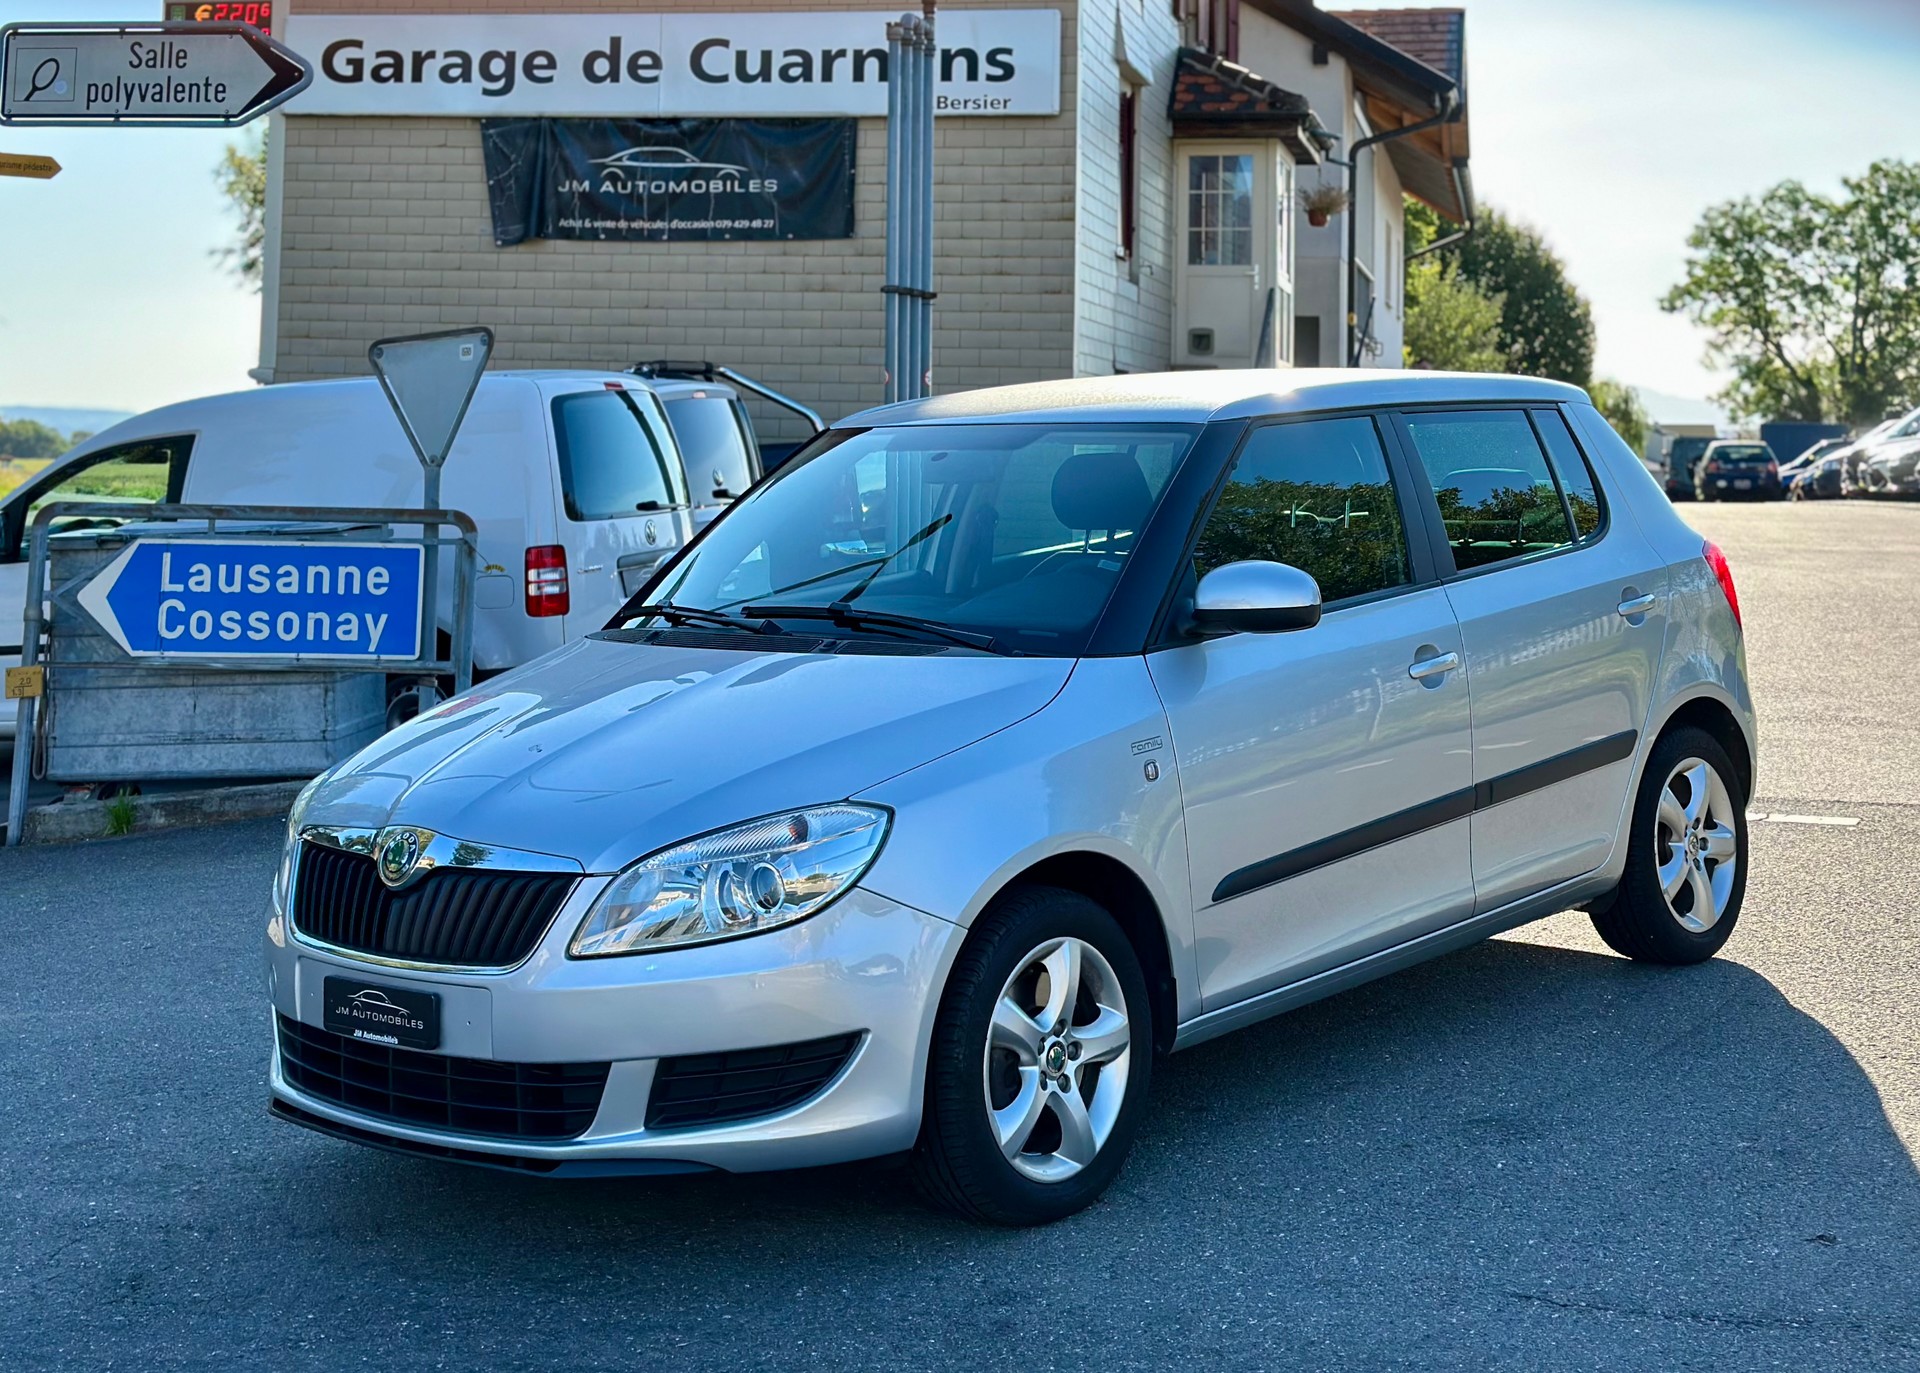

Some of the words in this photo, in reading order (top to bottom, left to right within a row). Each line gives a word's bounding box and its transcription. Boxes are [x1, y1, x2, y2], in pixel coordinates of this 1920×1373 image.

[128, 41, 188, 69] Salle
[321, 38, 558, 97] Garage
[581, 36, 663, 85] de
[688, 37, 1016, 84] Cuarnns
[86, 76, 227, 110] polyvalente
[936, 94, 1012, 110] Bersier
[557, 180, 590, 193] JM
[599, 179, 779, 194] AUTOMOBILES
[558, 218, 583, 229] Achat
[584, 218, 592, 229] &
[593, 219, 617, 229] vente
[617, 218, 629, 229] de
[630, 218, 670, 230] véhicules
[715, 220, 732, 229] 079
[733, 219, 749, 229] 429
[763, 219, 775, 229] 27
[160, 552, 390, 596] Lausanne
[158, 598, 389, 652] Cossonay
[335, 1006, 350, 1016] JM
[352, 1009, 424, 1030] AUTOMOBILES
